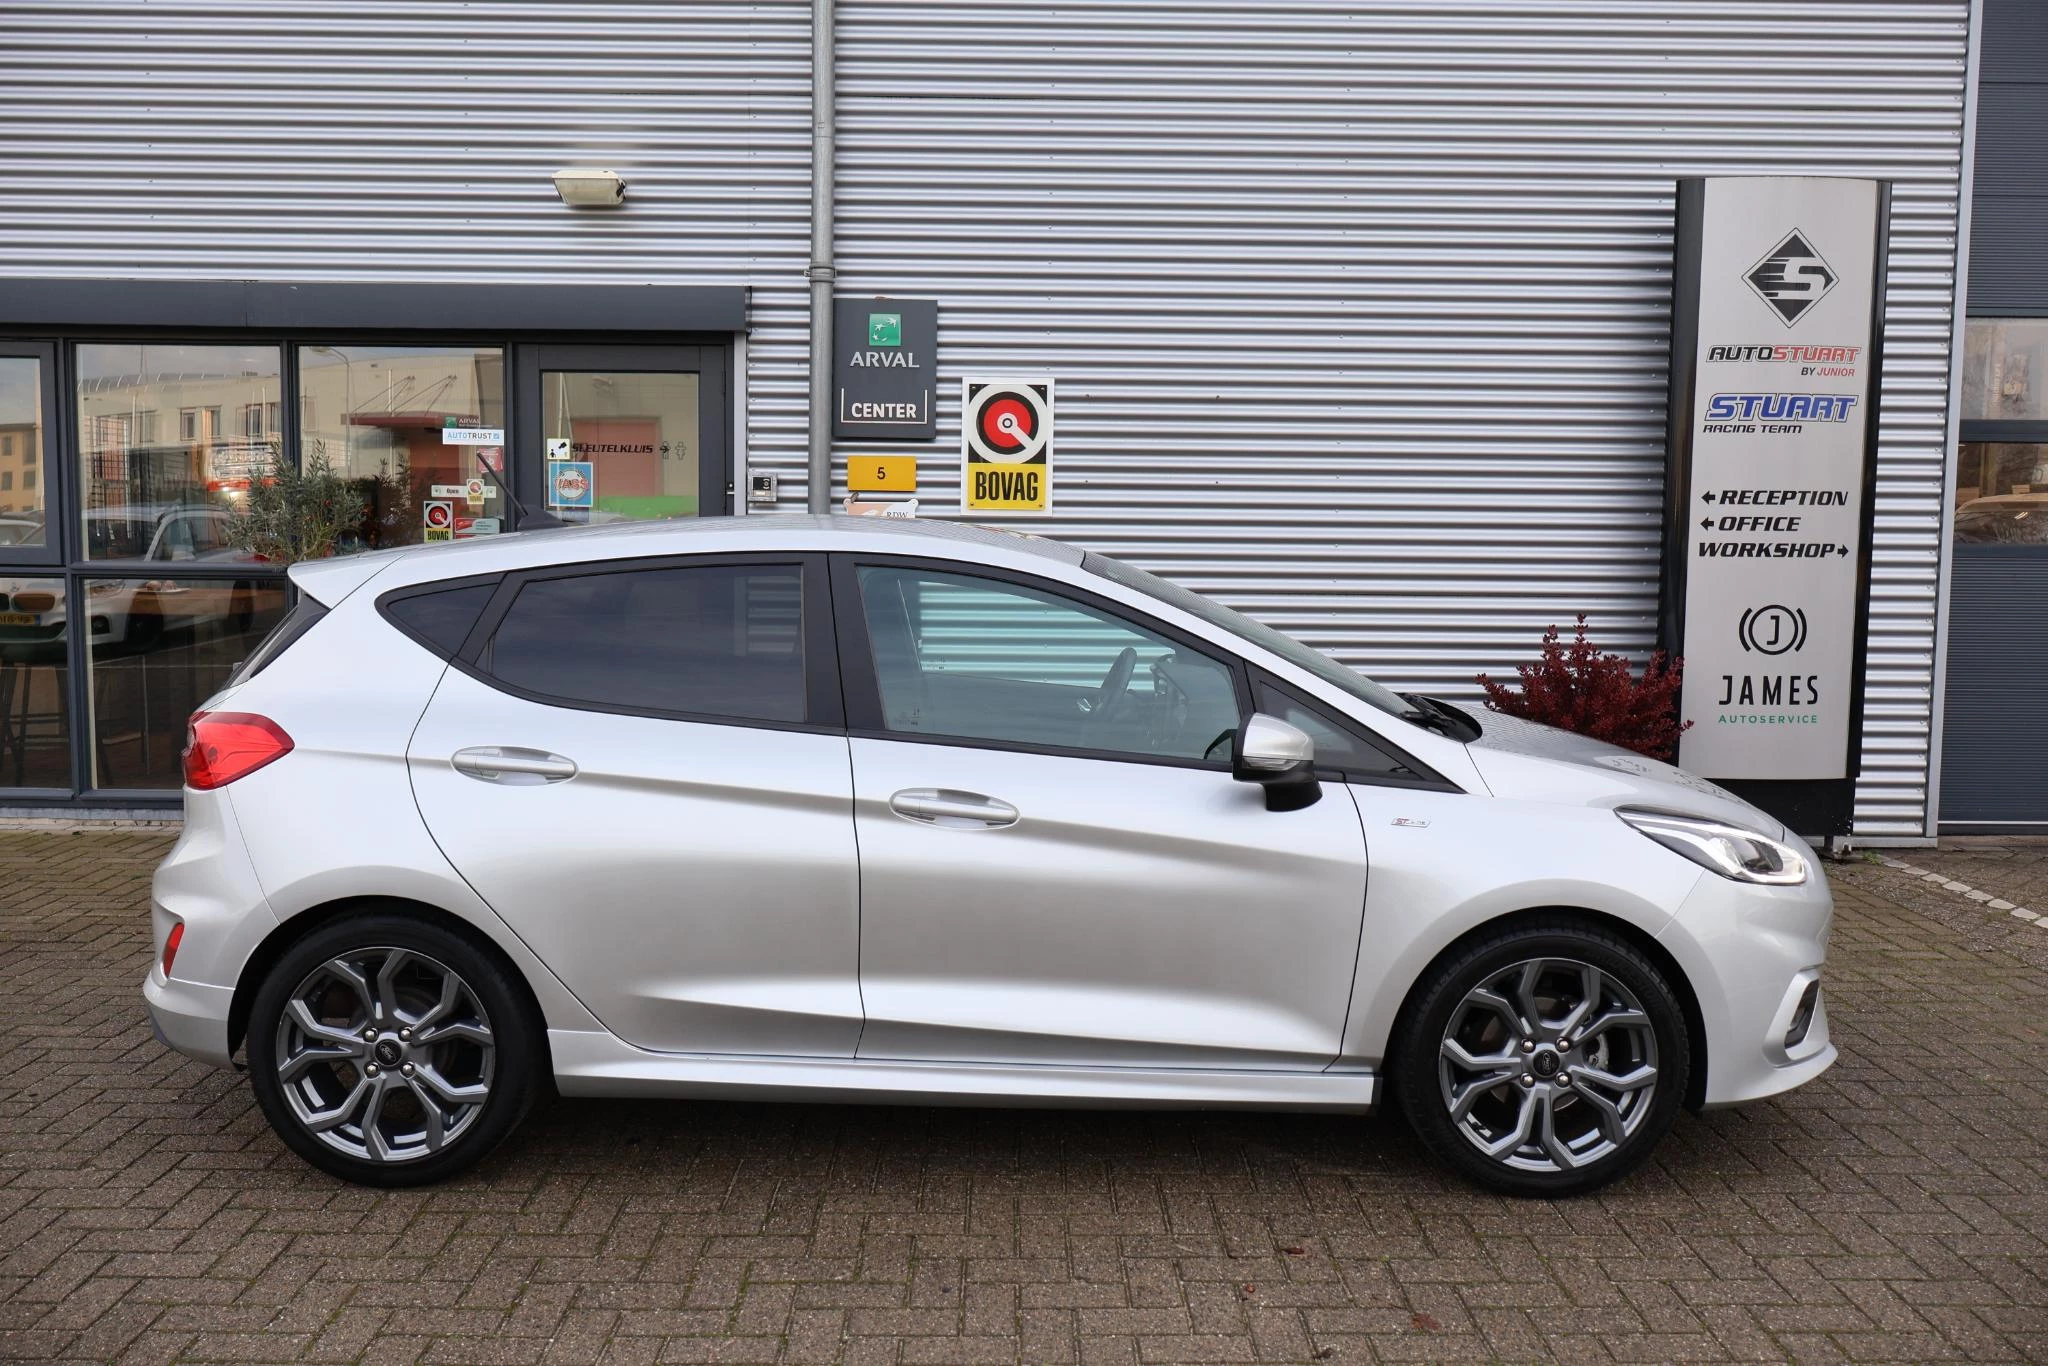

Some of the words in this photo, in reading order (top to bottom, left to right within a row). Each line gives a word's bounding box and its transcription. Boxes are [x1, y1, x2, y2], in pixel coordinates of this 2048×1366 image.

[850, 351, 920, 368] ARVAL
[1707, 345, 1860, 363] AUTOSTUART
[1801, 367, 1815, 376] BY
[1817, 367, 1855, 377] JUNIOR
[851, 402, 917, 418] CENTER
[1705, 393, 1859, 423] STUART
[1703, 424, 1756, 434] RACING
[1761, 424, 1802, 434] TEAM
[877, 466, 886, 480] 5
[975, 471, 1038, 501] BOVAG
[1719, 490, 1848, 506] RECEPTION
[1718, 516, 1801, 532] OFFICE
[427, 530, 449, 541] BOVAG
[1699, 542, 1835, 558] WORKSHOP
[1718, 675, 1818, 705] JAMES
[1718, 715, 1817, 724] AUTOSERVICE
